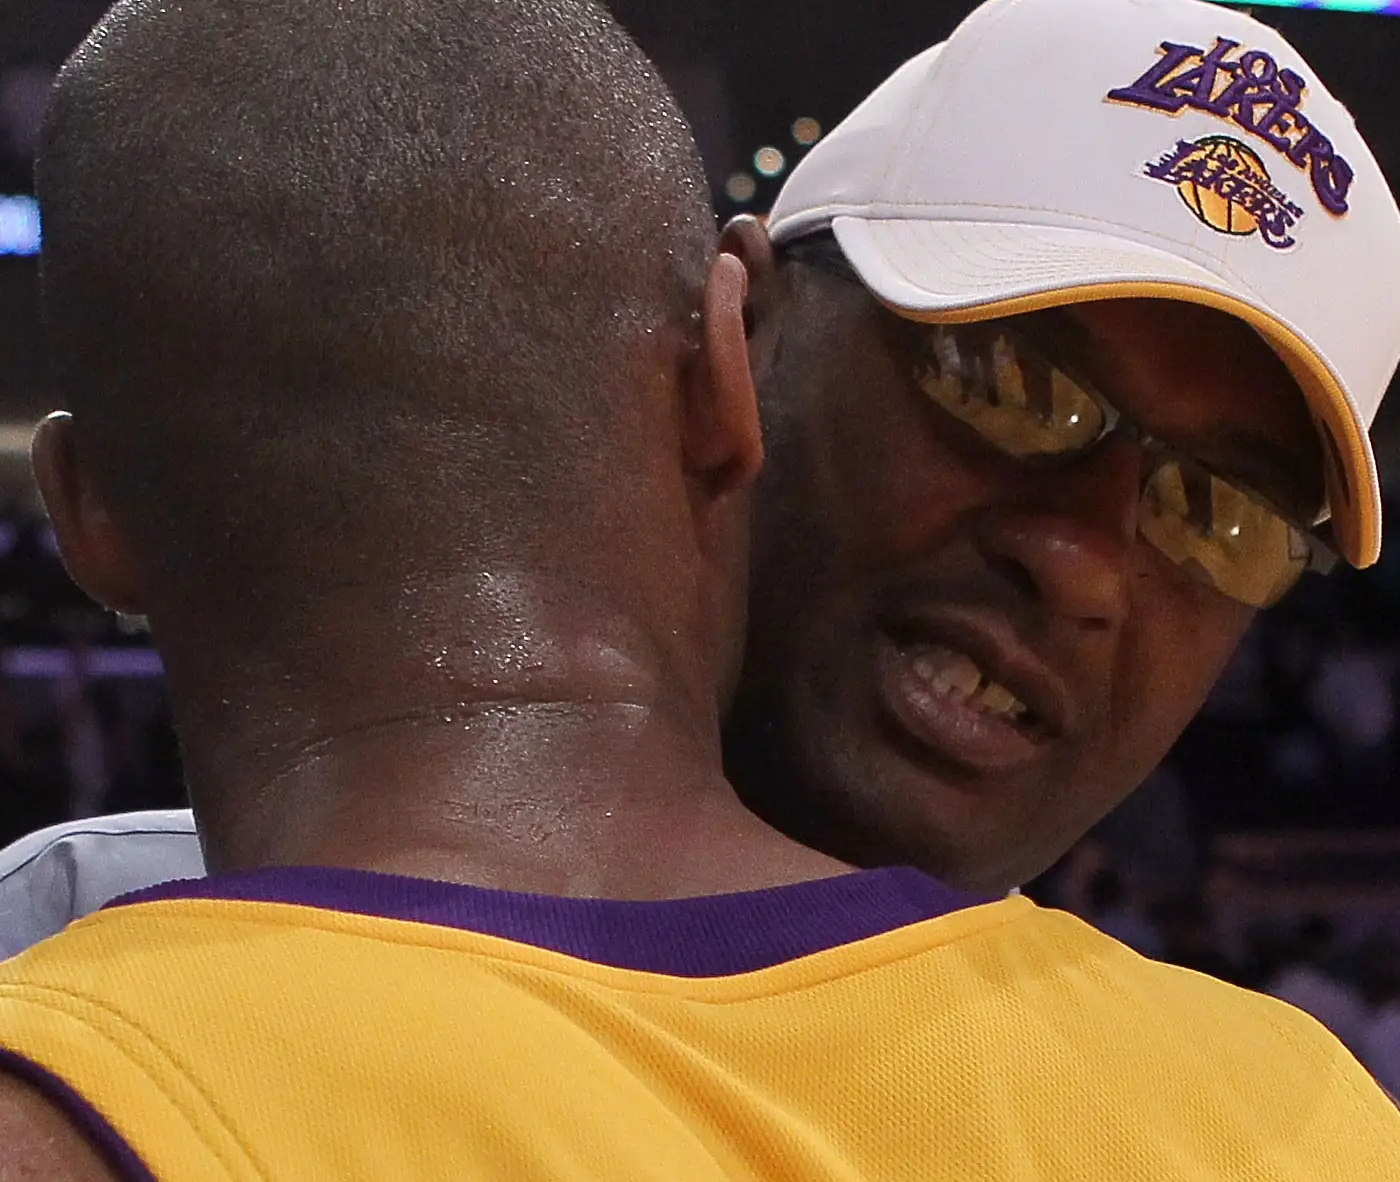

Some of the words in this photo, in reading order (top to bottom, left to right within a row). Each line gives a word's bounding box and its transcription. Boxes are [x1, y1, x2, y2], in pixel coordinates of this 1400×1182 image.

[1103, 40, 1355, 216] LAKERS
[1212, 36, 1307, 110] LOS
[1143, 139, 1298, 249] LAKERS
